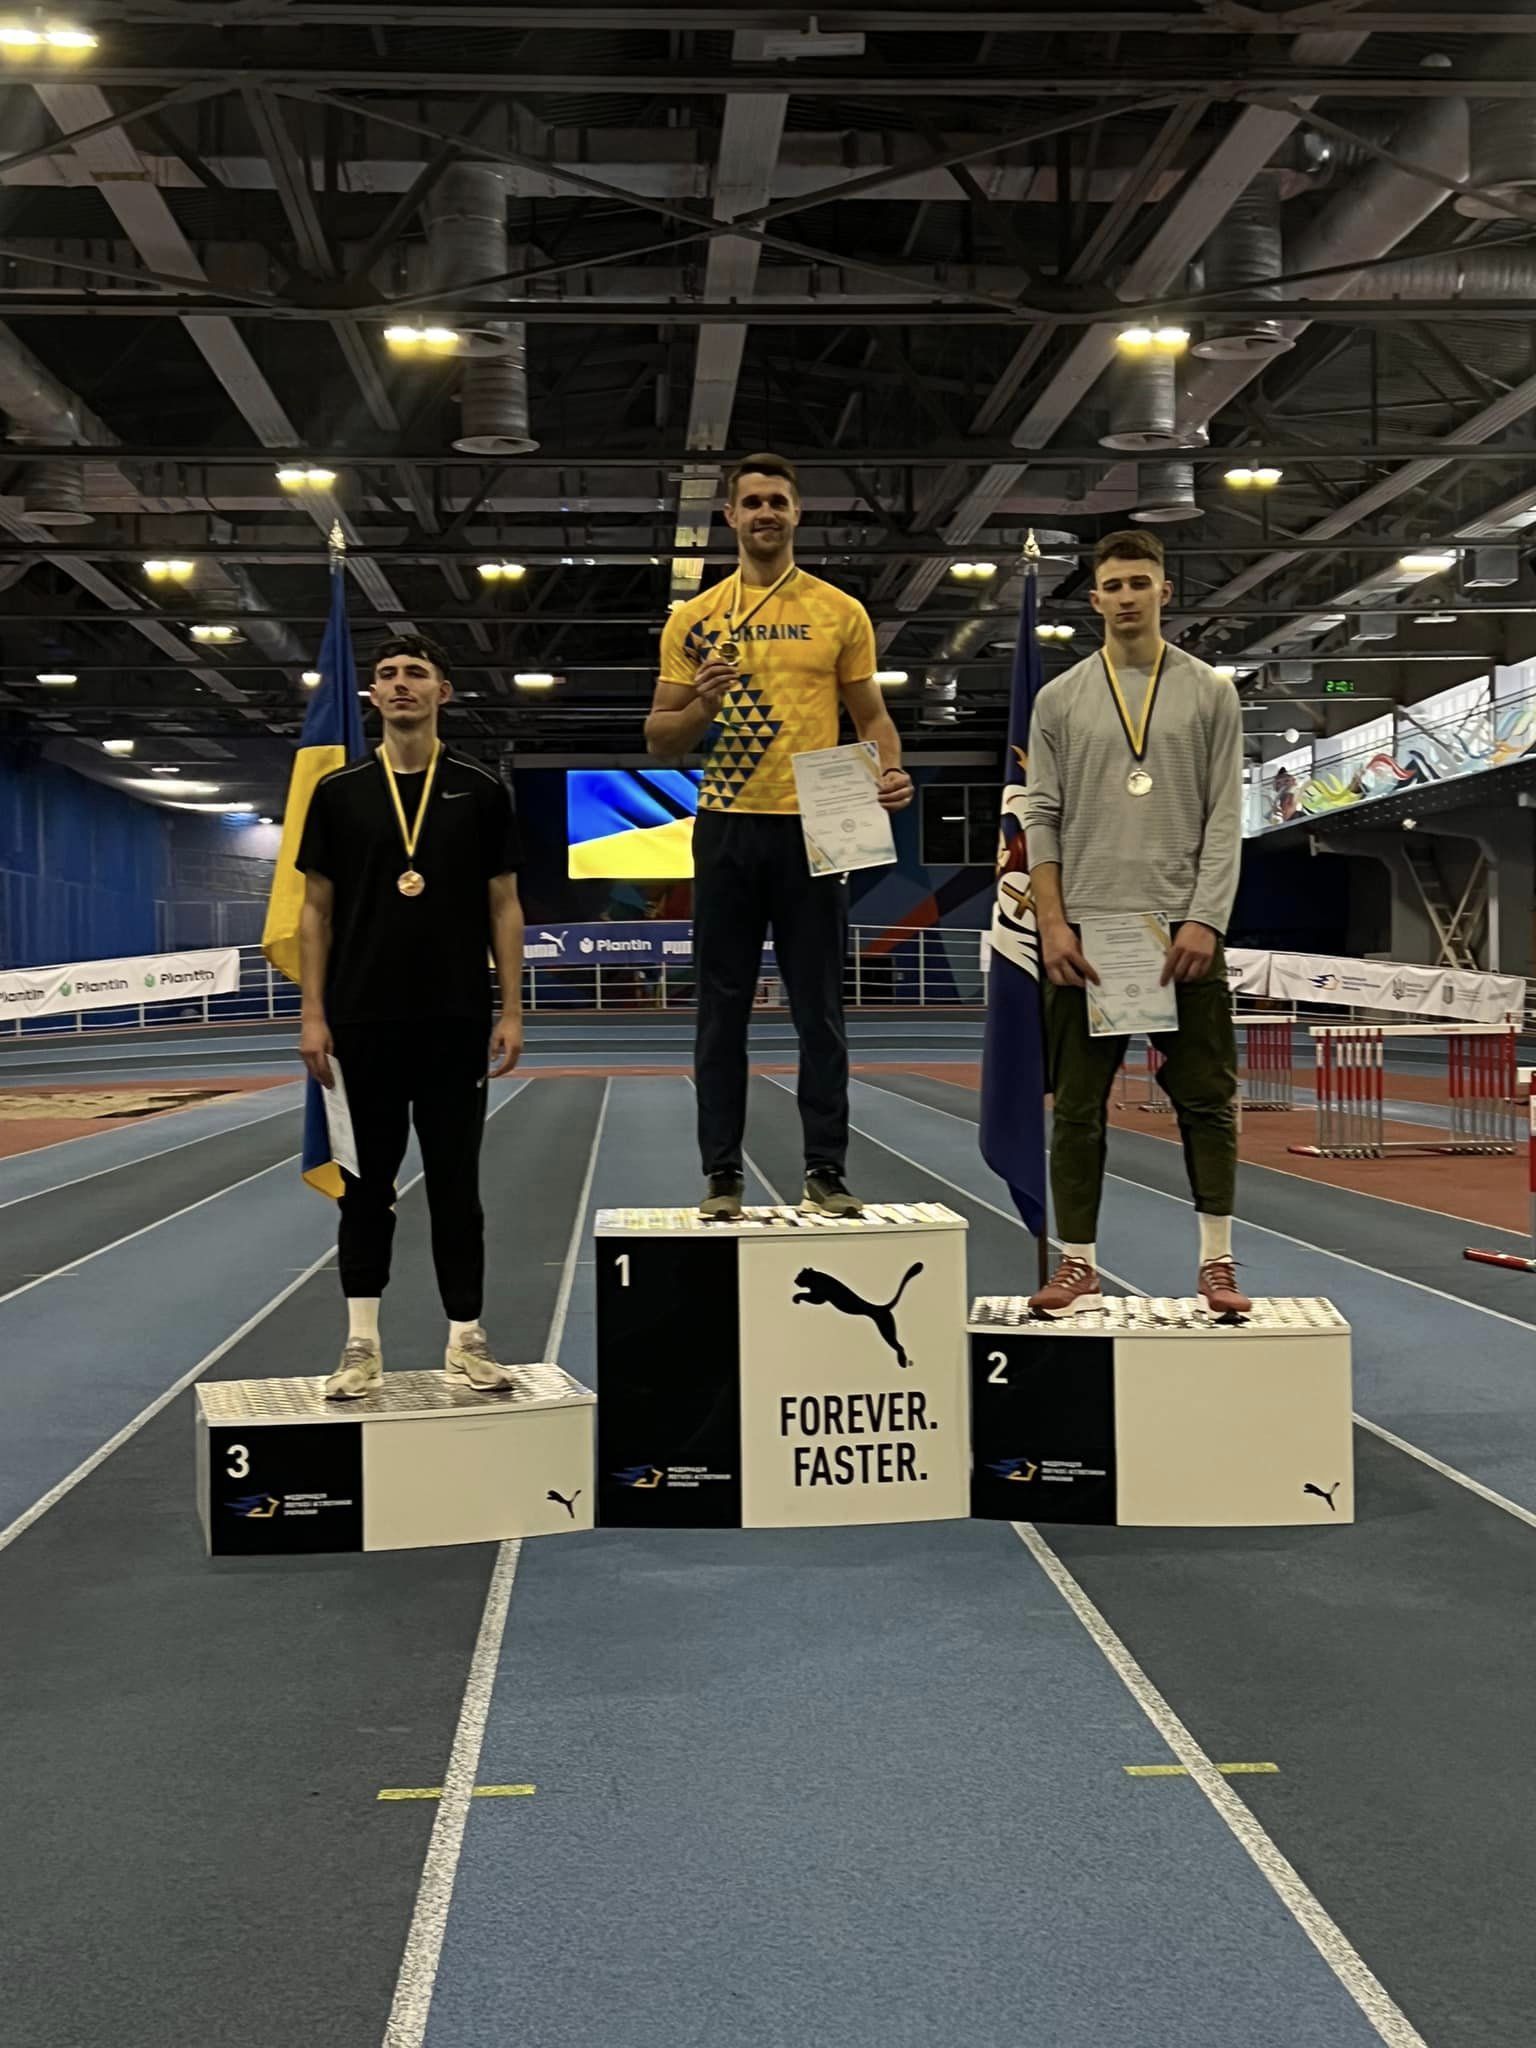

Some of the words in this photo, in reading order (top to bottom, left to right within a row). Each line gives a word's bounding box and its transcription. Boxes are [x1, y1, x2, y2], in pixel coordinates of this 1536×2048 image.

[732, 624, 812, 642] UKRAINE
[596, 939, 652, 951] Plantin
[75, 978, 129, 993] Plantin
[160, 970, 215, 985] Plantin
[0, 988, 45, 1002] lantin
[615, 1254, 630, 1287] 1
[987, 1351, 1009, 1384] 2
[780, 1391, 938, 1437] FOREVER.
[226, 1444, 250, 1479] 3
[794, 1442, 928, 1487] FASTER.
